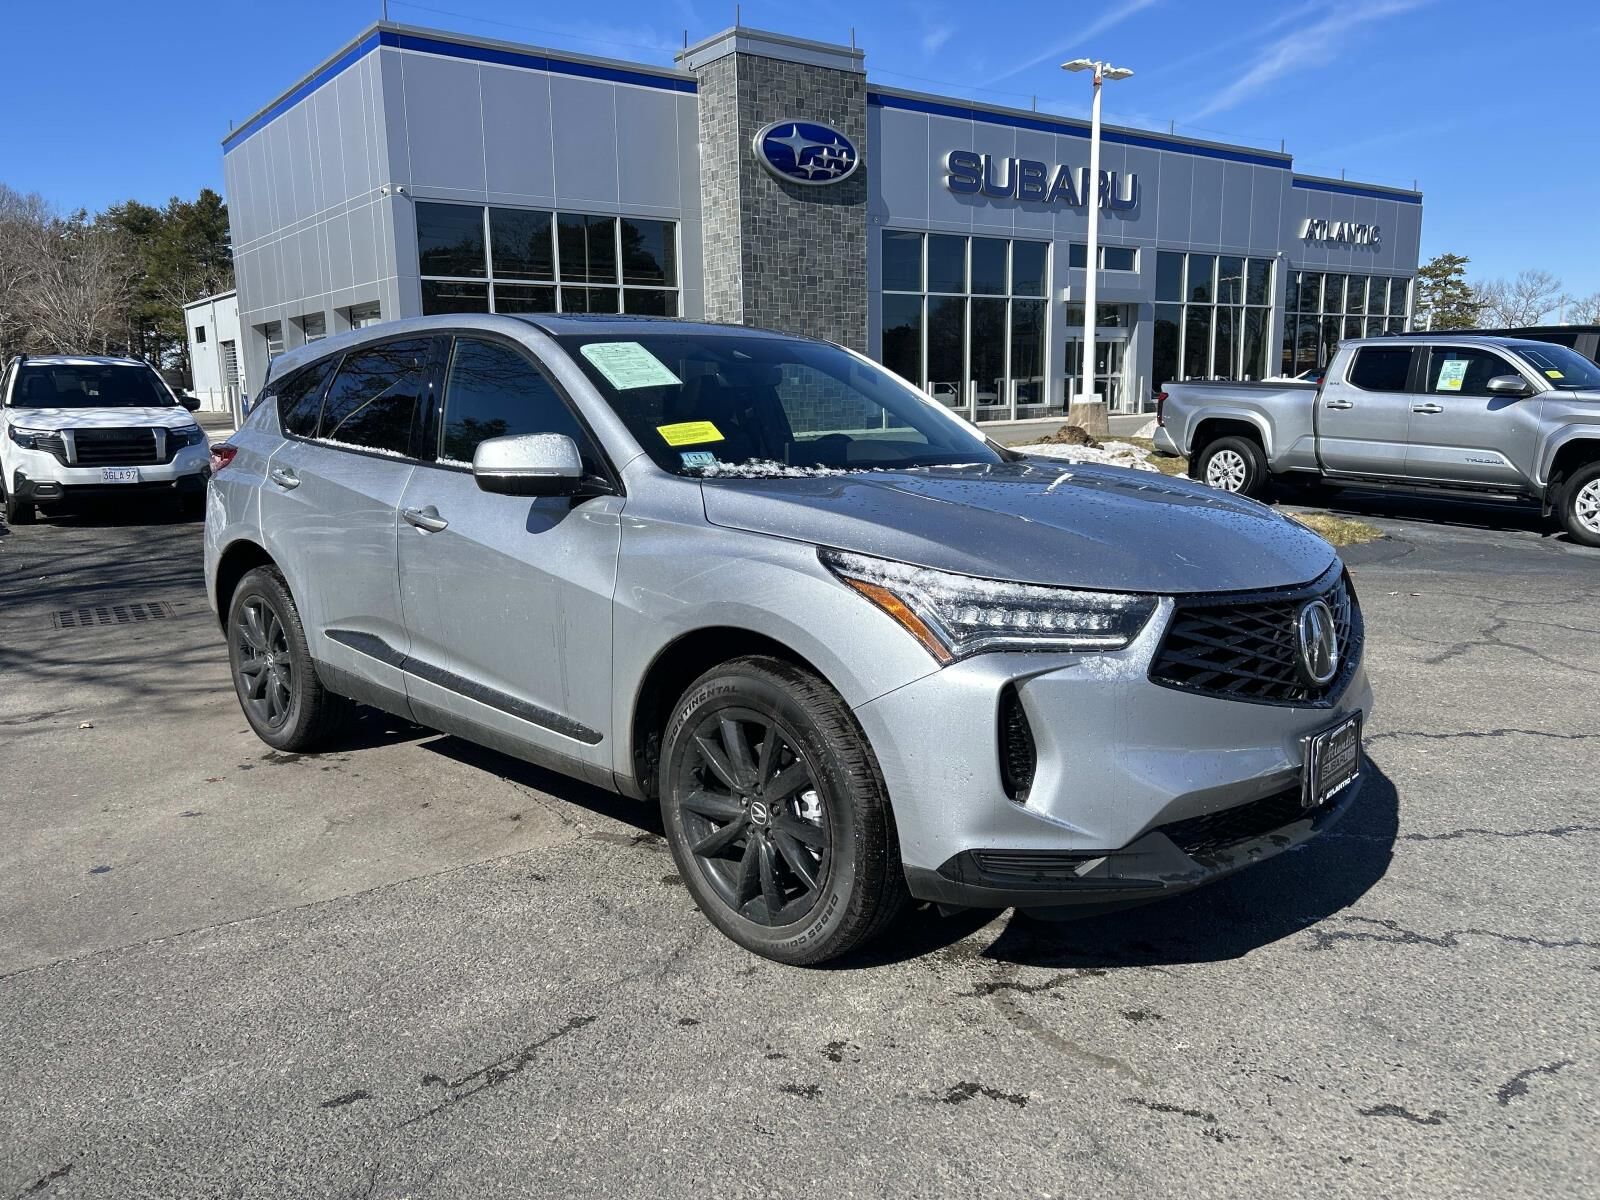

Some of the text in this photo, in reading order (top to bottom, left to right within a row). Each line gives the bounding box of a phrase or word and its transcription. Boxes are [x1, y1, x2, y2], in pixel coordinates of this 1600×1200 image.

[944, 150, 1140, 210] SUBARU
[1299, 218, 1382, 246] ATLANTIC
[668, 685, 739, 746] CONTINENTAL
